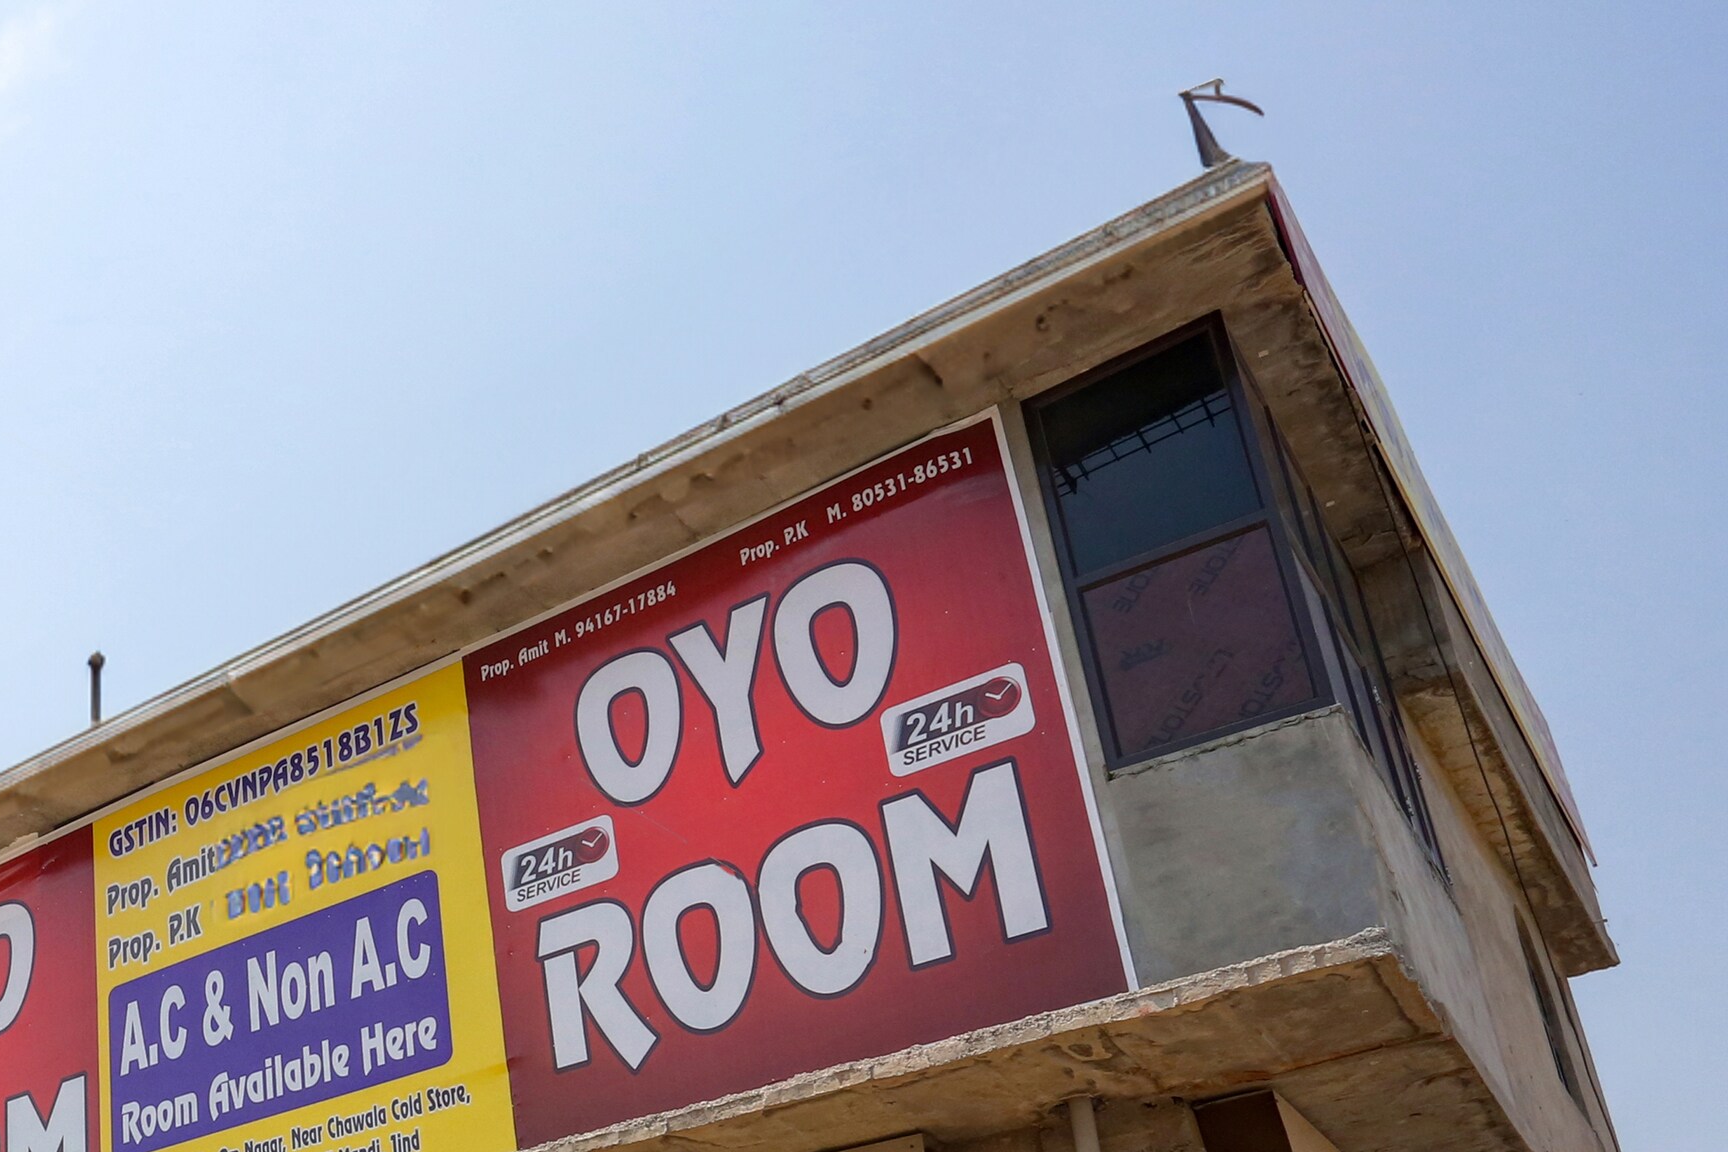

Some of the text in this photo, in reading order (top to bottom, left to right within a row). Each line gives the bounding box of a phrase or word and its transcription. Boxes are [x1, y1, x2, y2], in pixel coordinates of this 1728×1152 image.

[738, 446, 974, 566] Prop. P.K M. 80531-86531
[480, 580, 677, 682] Prop. Amit M. 94167-17884
[575, 558, 898, 806] OYO
[901, 722, 987, 767] SERVICE
[905, 699, 975, 747] 24h
[108, 807, 178, 857] GSTIN:
[519, 847, 573, 885] 24h
[106, 877, 159, 916] Prop.
[166, 845, 217, 894] Amit
[515, 868, 582, 903] SERVICE
[107, 903, 202, 970] Prop. P.K
[536, 757, 1051, 1074] ROOM
[119, 896, 432, 1078] A.C & Non A.C
[121, 1015, 438, 1145] Room Available Here
[290, 1122, 323, 1150] Near
[327, 1104, 388, 1140] Chawala
[390, 1092, 422, 1122] Cold
[426, 1082, 472, 1112] Store,
